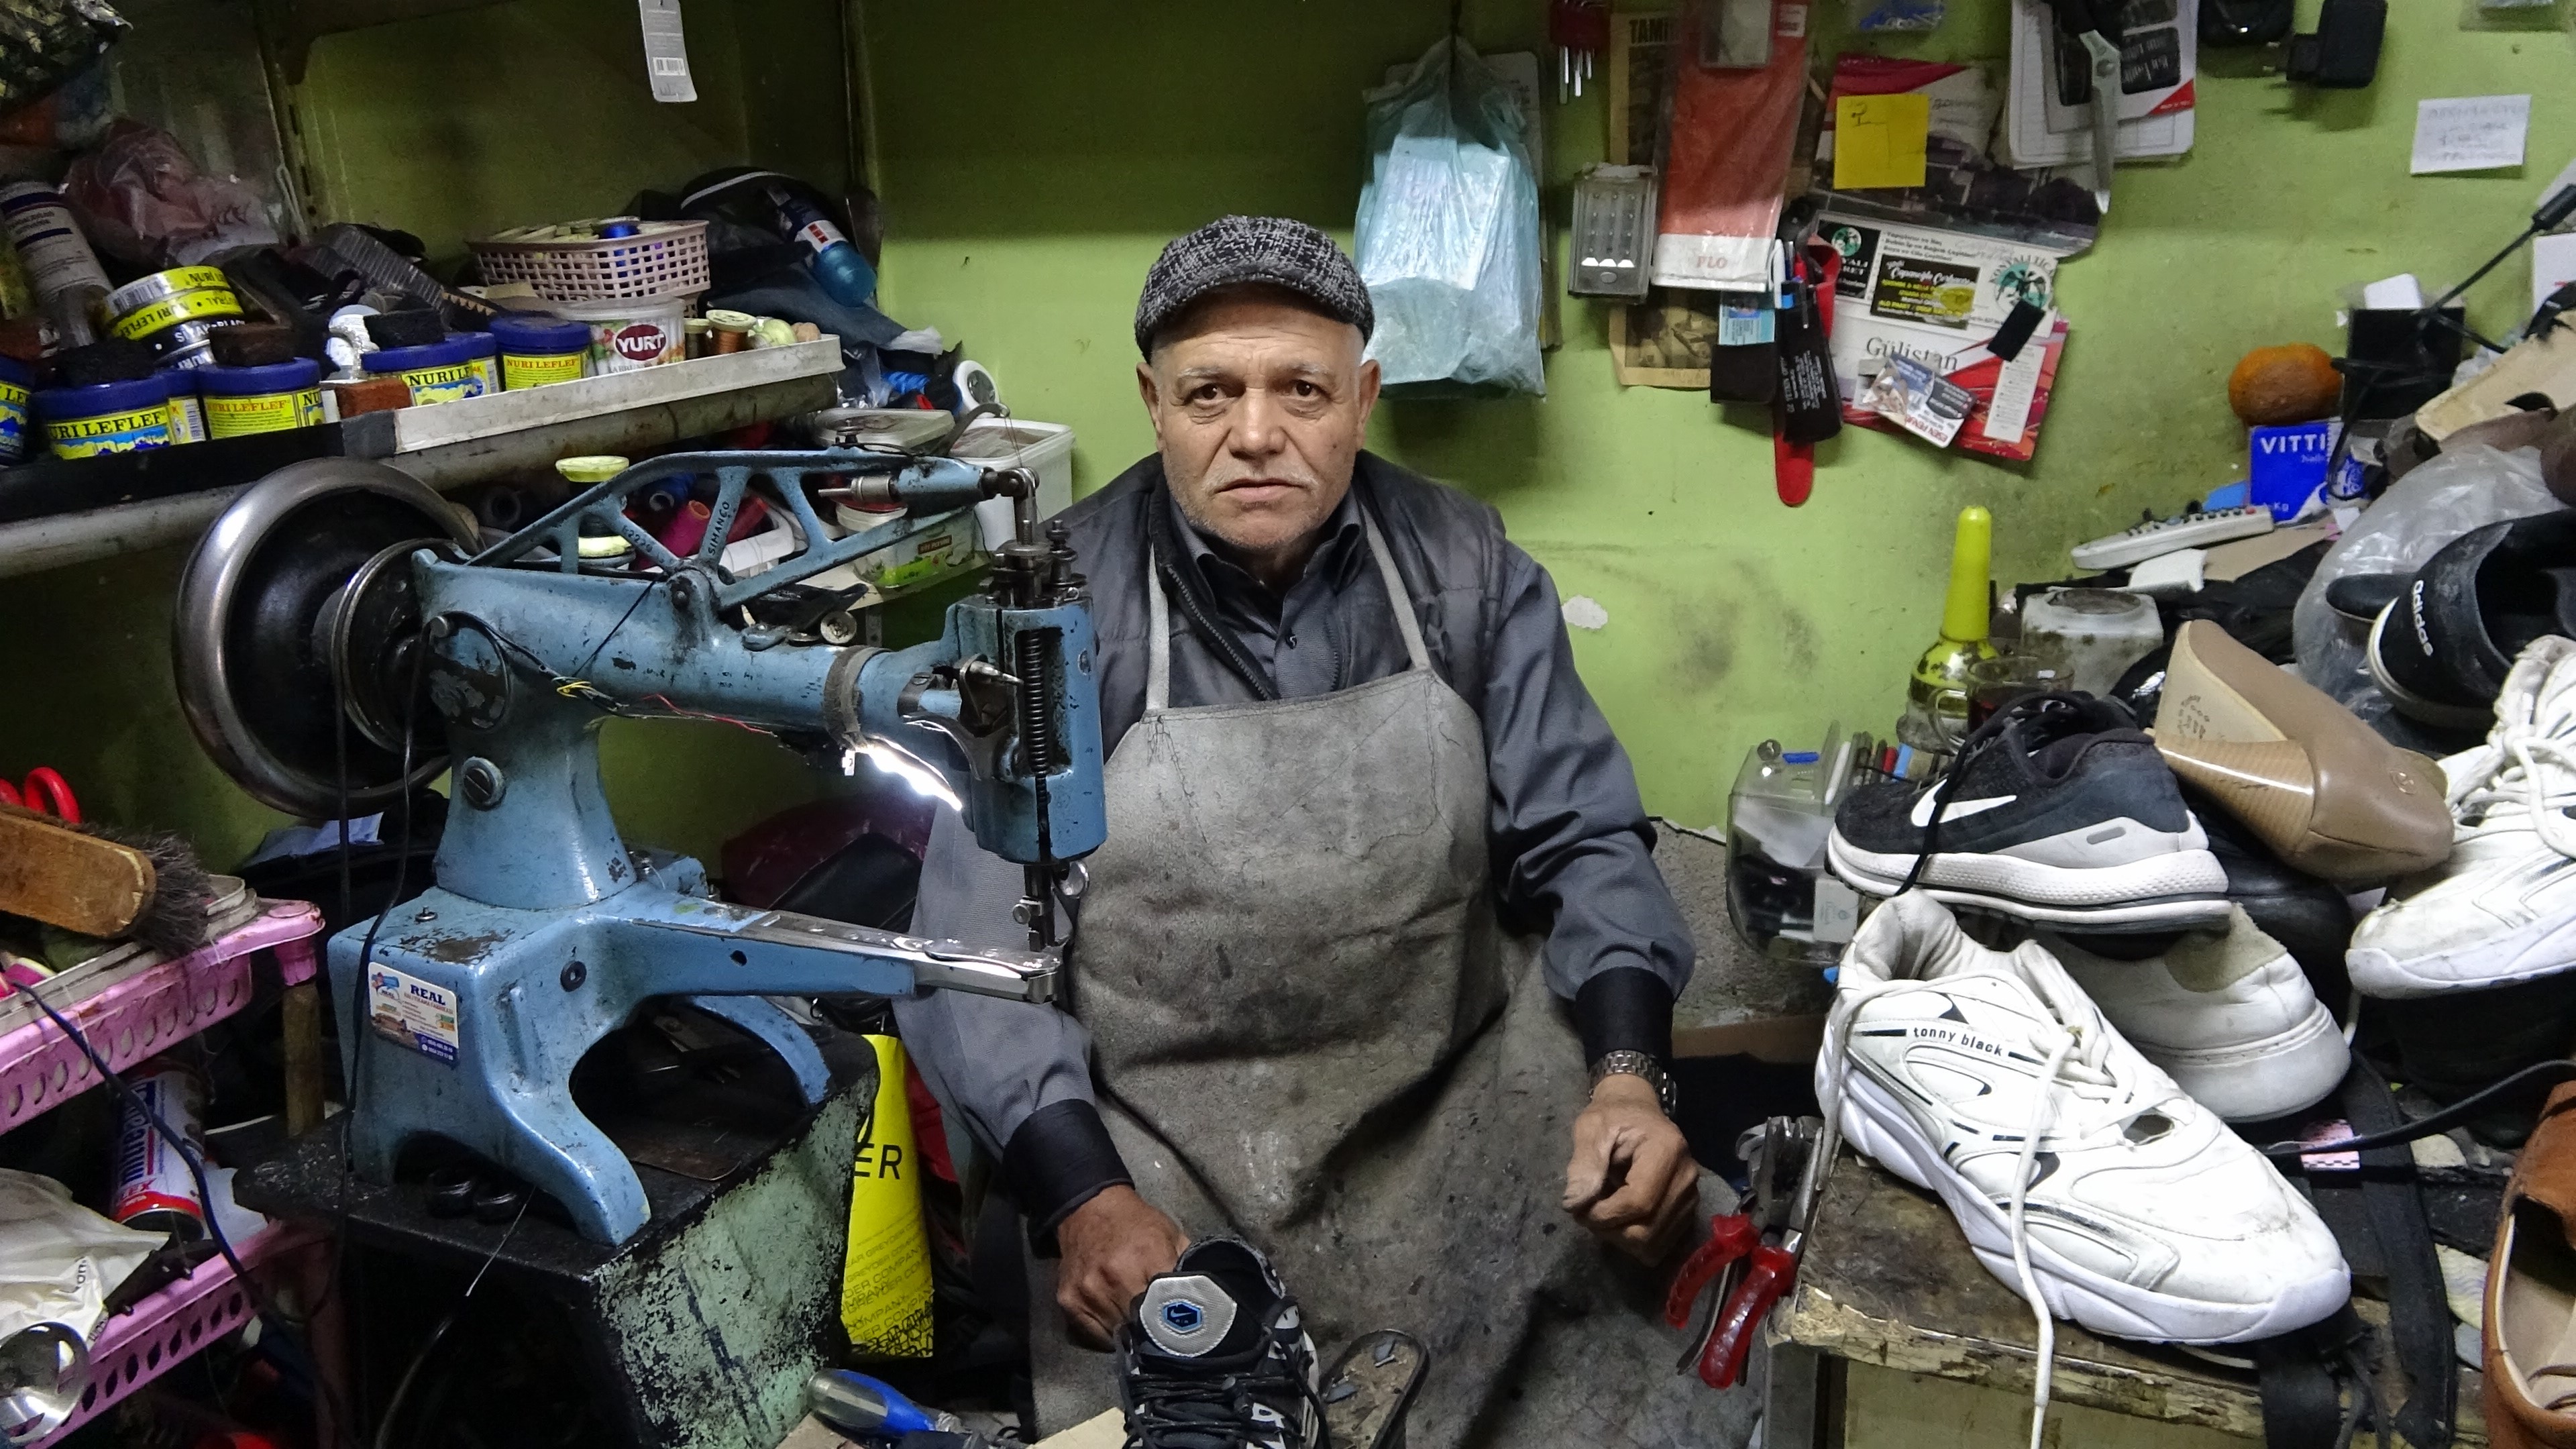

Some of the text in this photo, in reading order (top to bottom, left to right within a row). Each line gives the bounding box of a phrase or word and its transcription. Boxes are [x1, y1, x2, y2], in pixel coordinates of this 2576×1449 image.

[617, 333, 665, 353] YURT
[507, 357, 578, 368] NURI LEFLEF
[408, 367, 457, 386] NURI
[233, 398, 286, 413] LEFLEF
[85, 410, 162, 437] LEFLEF
[410, 983, 446, 1006] REAL
[1913, 1027, 2002, 1057] tonny black
